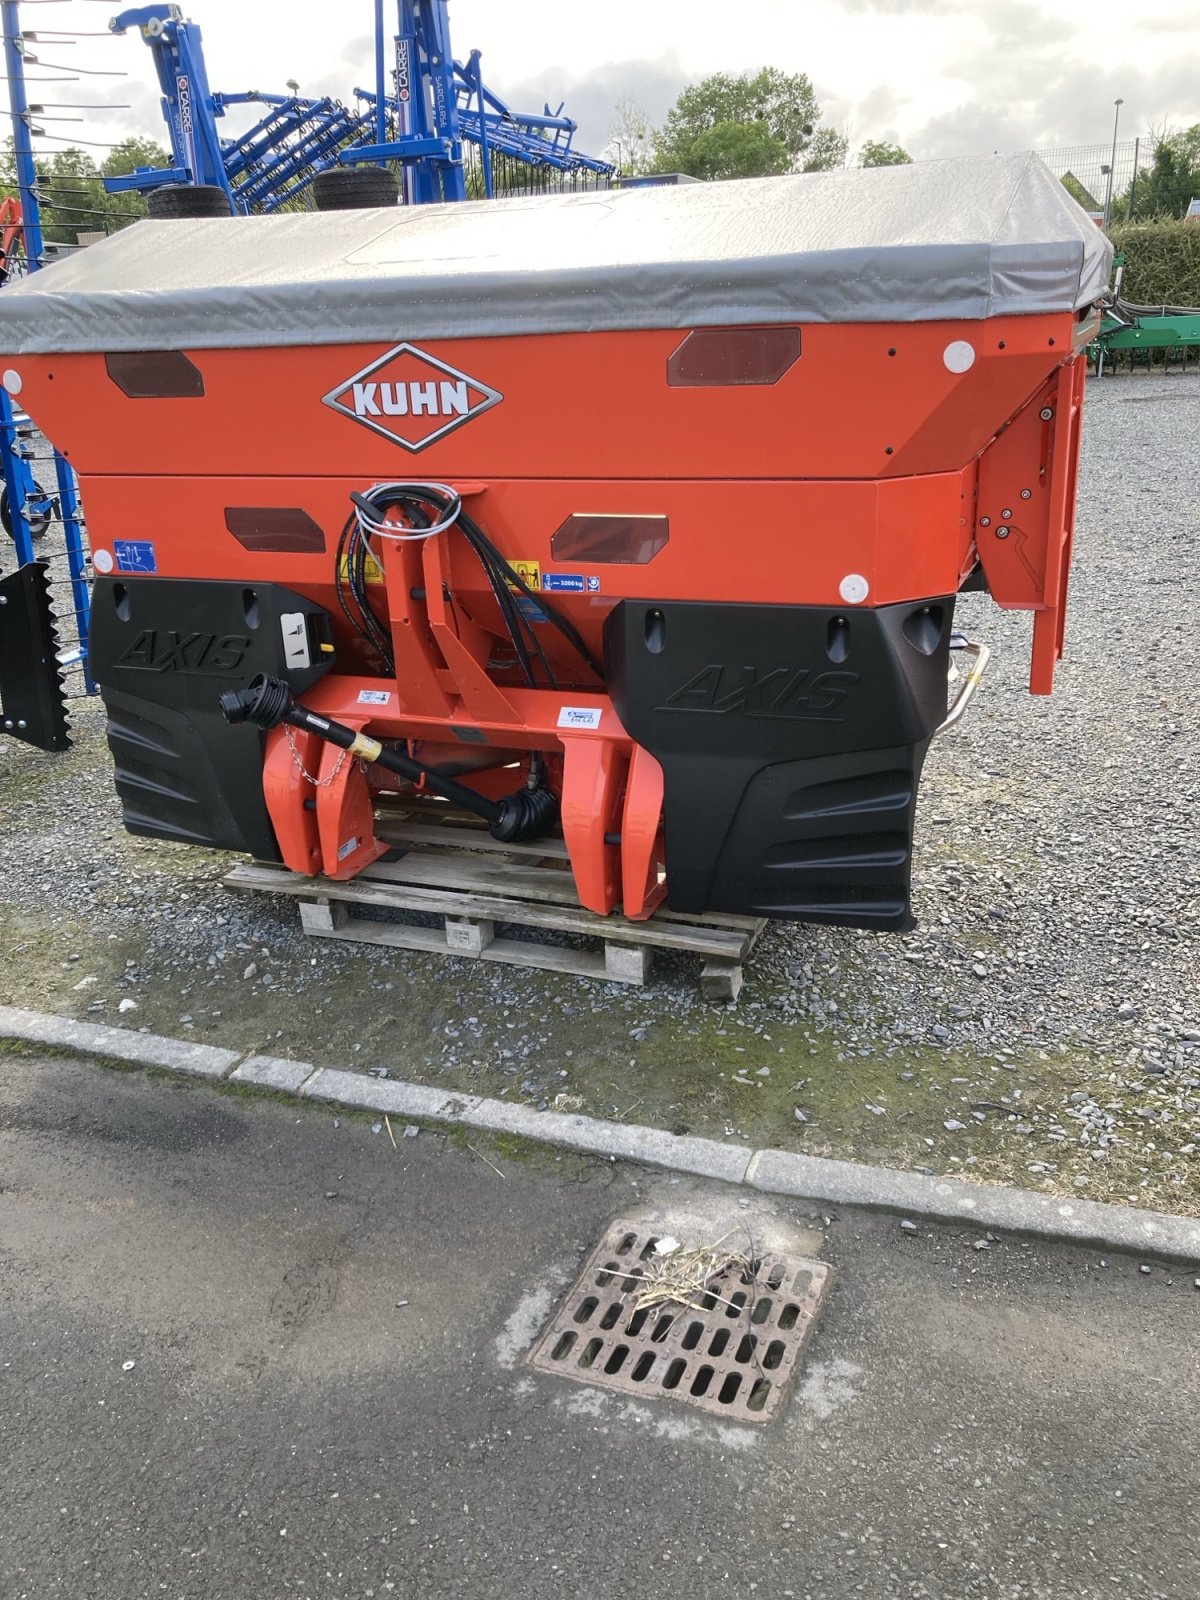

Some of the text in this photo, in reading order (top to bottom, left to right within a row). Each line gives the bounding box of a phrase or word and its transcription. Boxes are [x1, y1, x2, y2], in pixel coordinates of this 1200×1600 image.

[352, 381, 469, 416] KUHN
[114, 629, 252, 675] AXIS
[658, 664, 861, 714] AXIS
